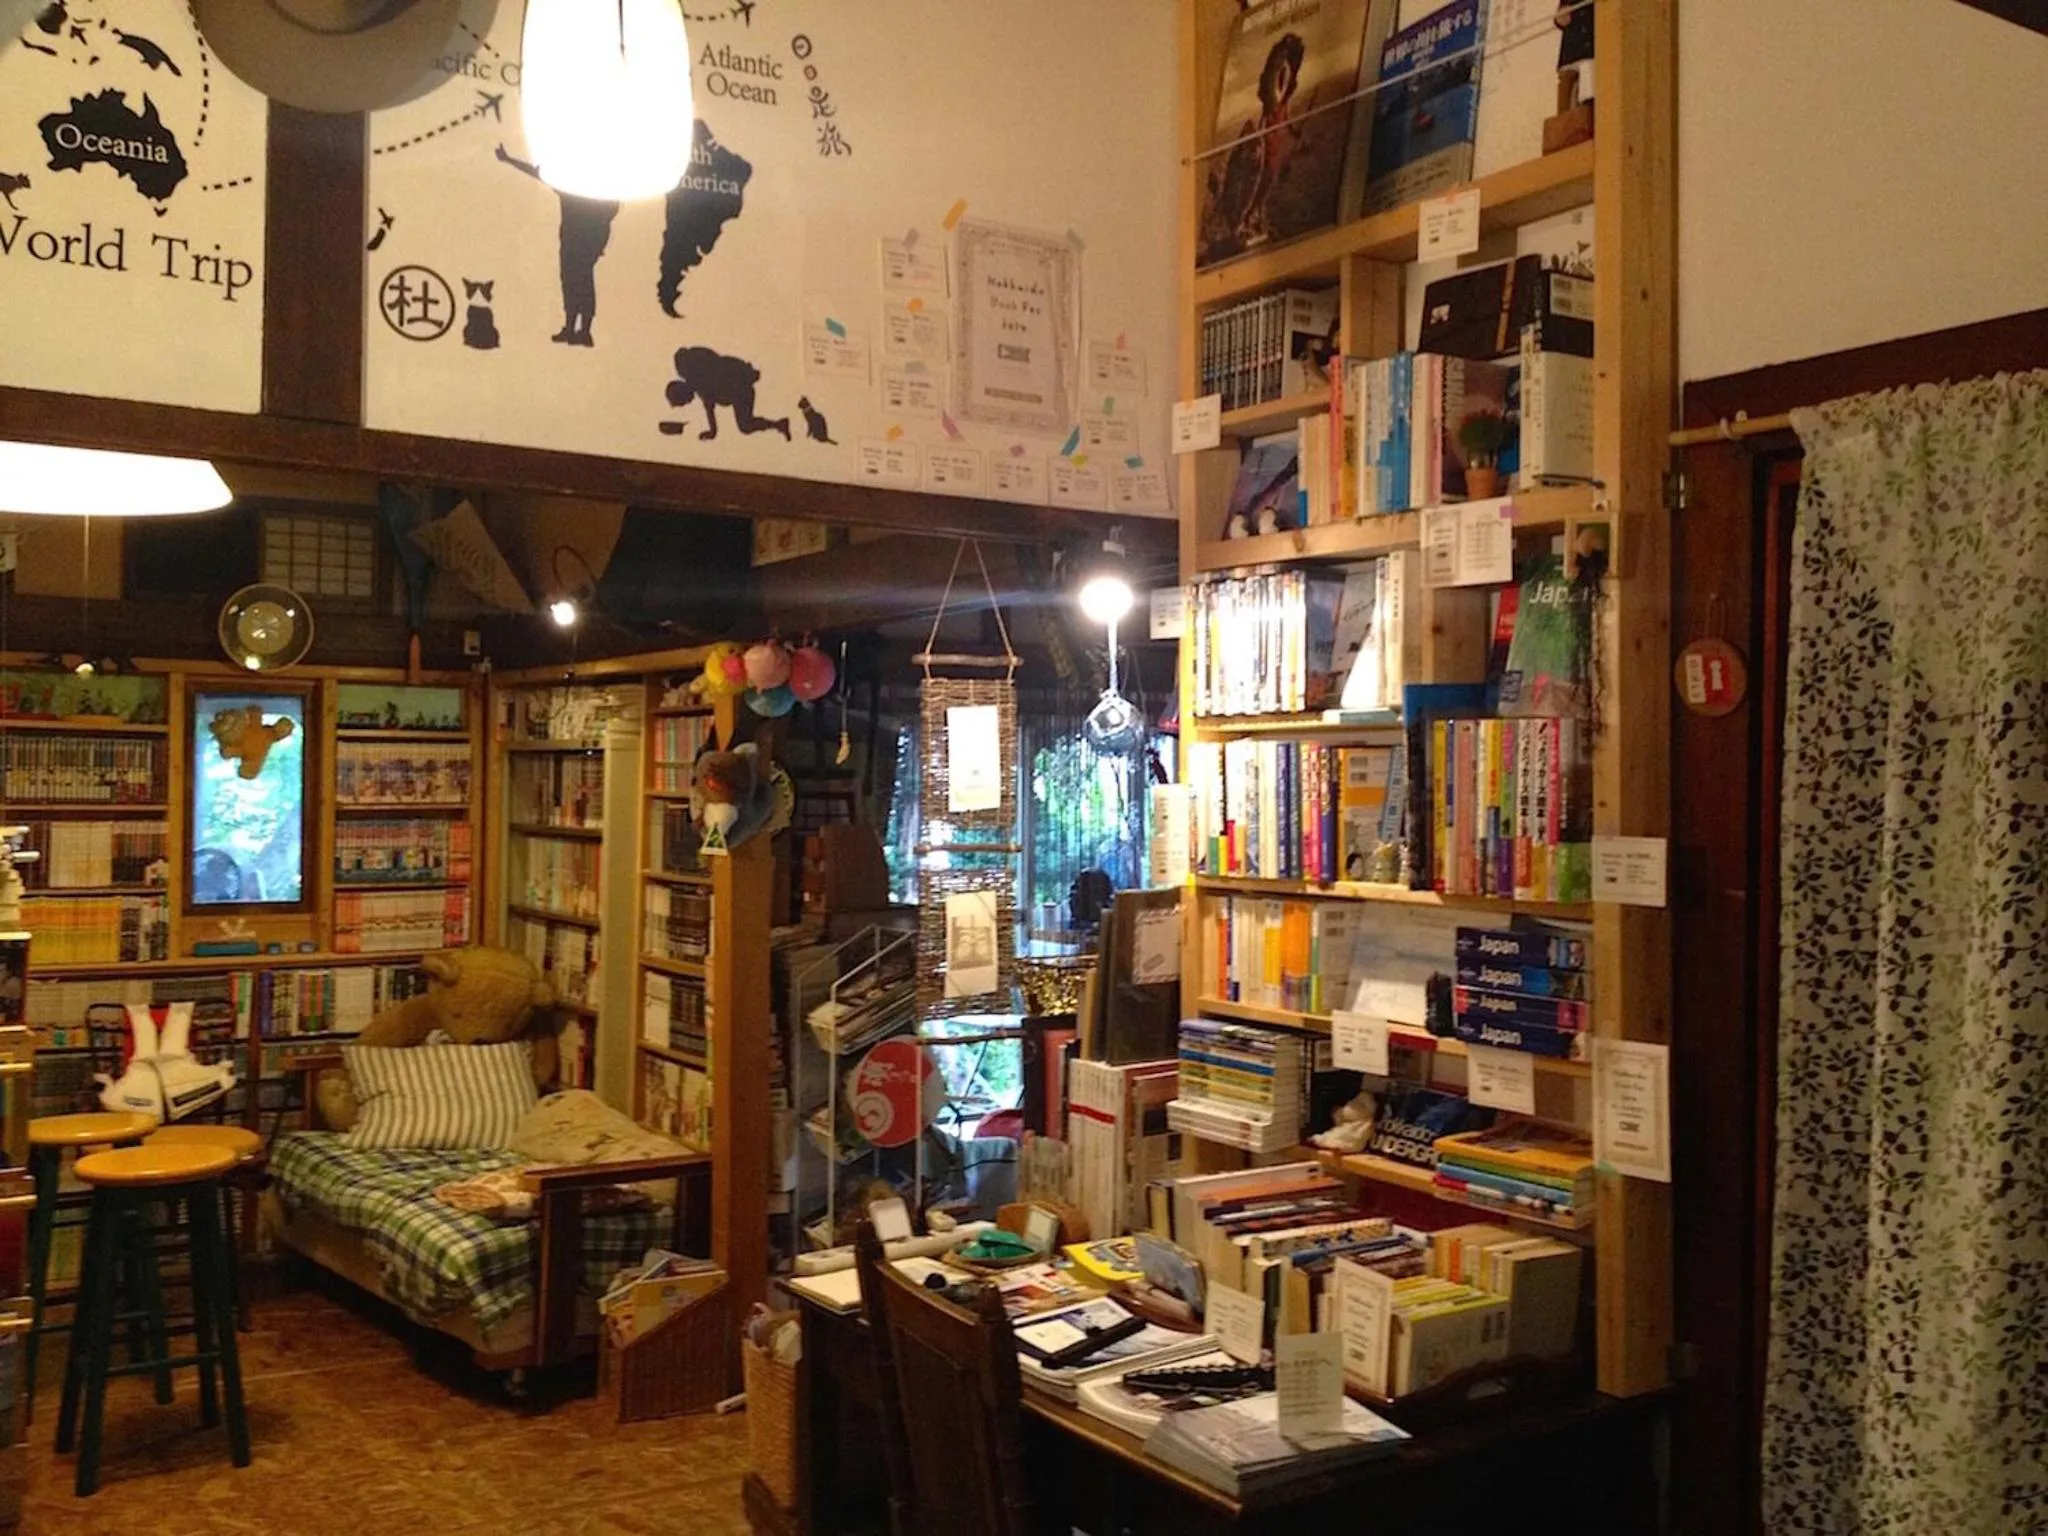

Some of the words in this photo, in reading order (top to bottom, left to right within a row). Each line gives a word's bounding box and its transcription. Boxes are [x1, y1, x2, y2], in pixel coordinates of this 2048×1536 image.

[699, 43, 784, 80] Atlantic
[706, 71, 777, 106] Ocean
[55, 123, 169, 164] Oceania
[151, 233, 253, 302] Trip
[1479, 934, 1520, 956] Japan
[1479, 965, 1523, 988] Japan
[1479, 994, 1518, 1013] Japan
[1479, 1022, 1522, 1046] Japan
